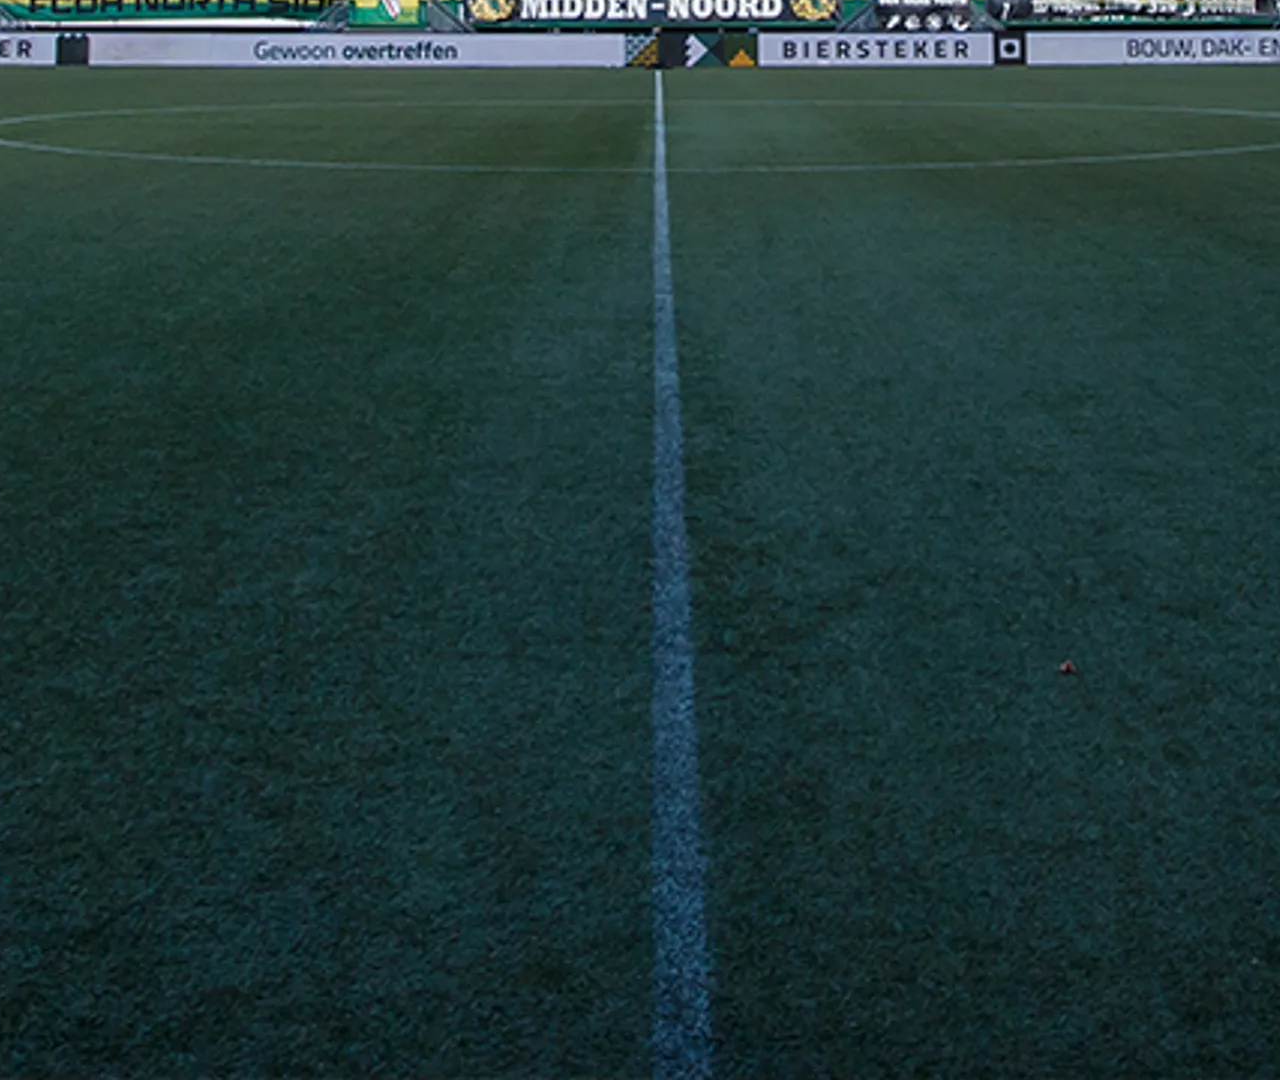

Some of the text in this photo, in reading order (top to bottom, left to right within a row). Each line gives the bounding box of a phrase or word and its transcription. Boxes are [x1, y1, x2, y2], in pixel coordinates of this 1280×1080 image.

[253, 39, 458, 62] Gewoon overtreffen
[783, 40, 969, 59] BIERSTEKER
[1127, 37, 1197, 60] BOUW,
